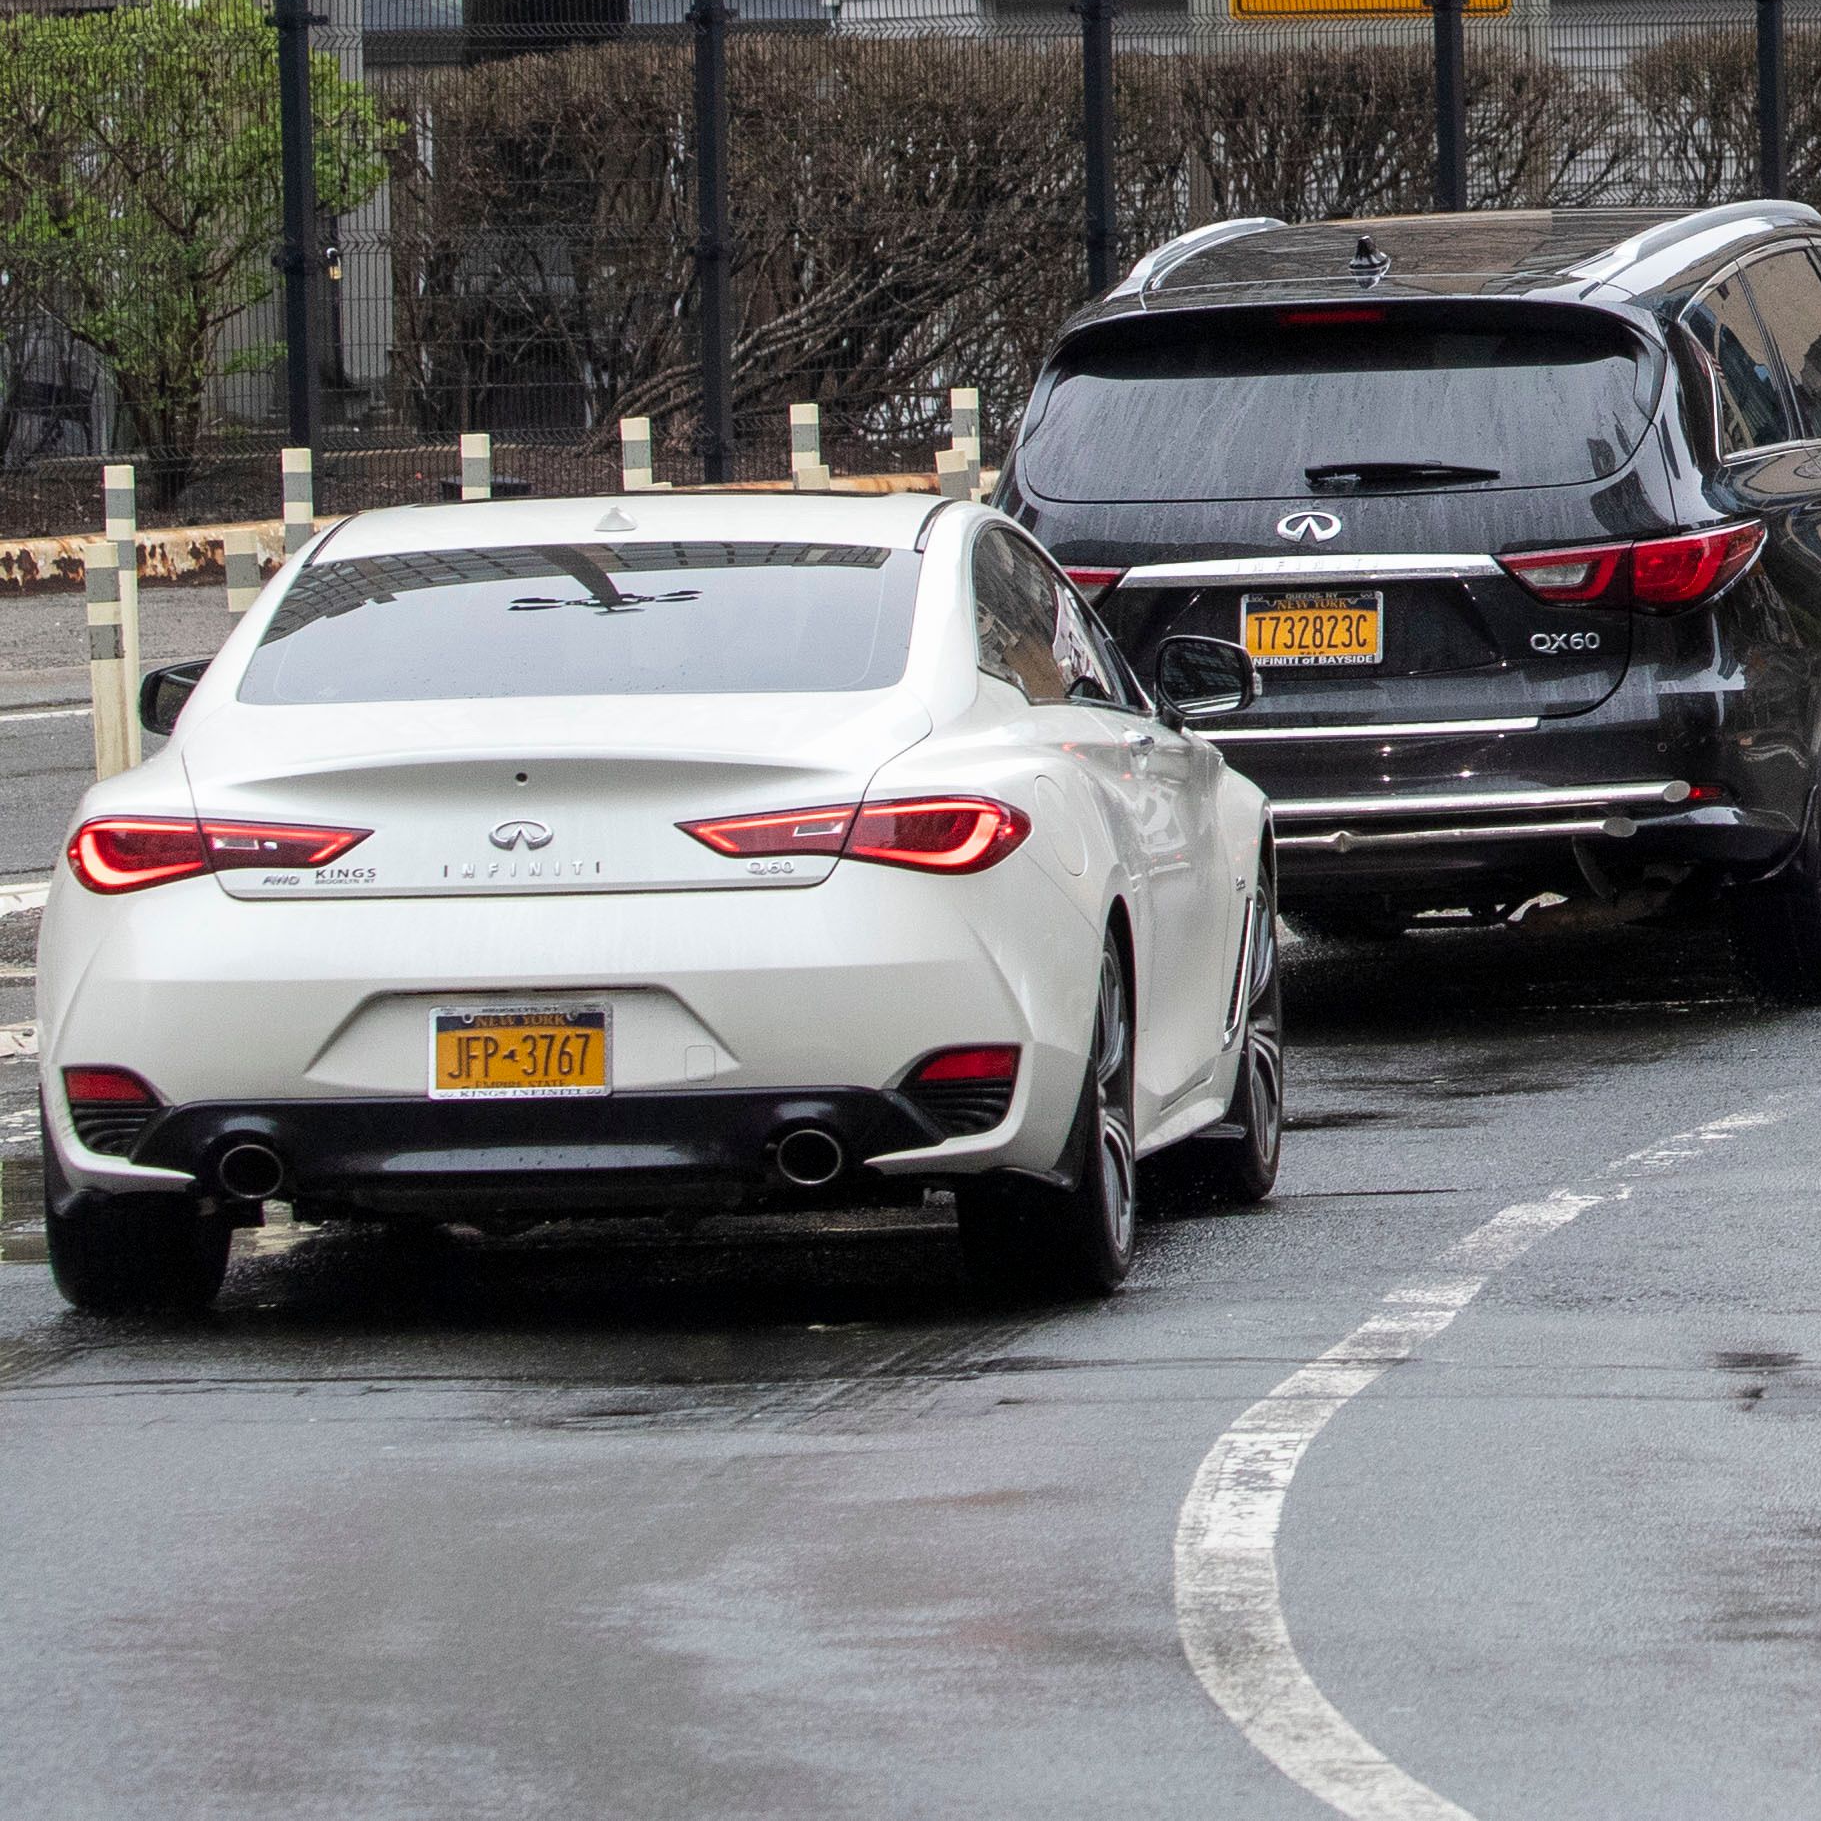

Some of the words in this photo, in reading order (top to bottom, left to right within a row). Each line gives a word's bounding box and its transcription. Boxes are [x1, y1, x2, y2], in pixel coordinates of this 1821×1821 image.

[1277, 600, 1308, 610] NEW
[1314, 599, 1348, 609] YORK
[1254, 614, 1367, 650] T732823C
[1530, 632, 1600, 654] QX60
[1253, 656, 1299, 666] NFINITI
[1303, 656, 1315, 665] of
[1318, 654, 1373, 665] BAYSIDE
[315, 868, 377, 879] KINGS
[444, 861, 601, 878] INFINITI
[746, 860, 795, 876] Q60
[474, 1015, 516, 1028] NEW
[525, 1014, 566, 1027] YORK
[459, 1090, 508, 1099] KINGS
[513, 1088, 581, 1096] INFINITI
